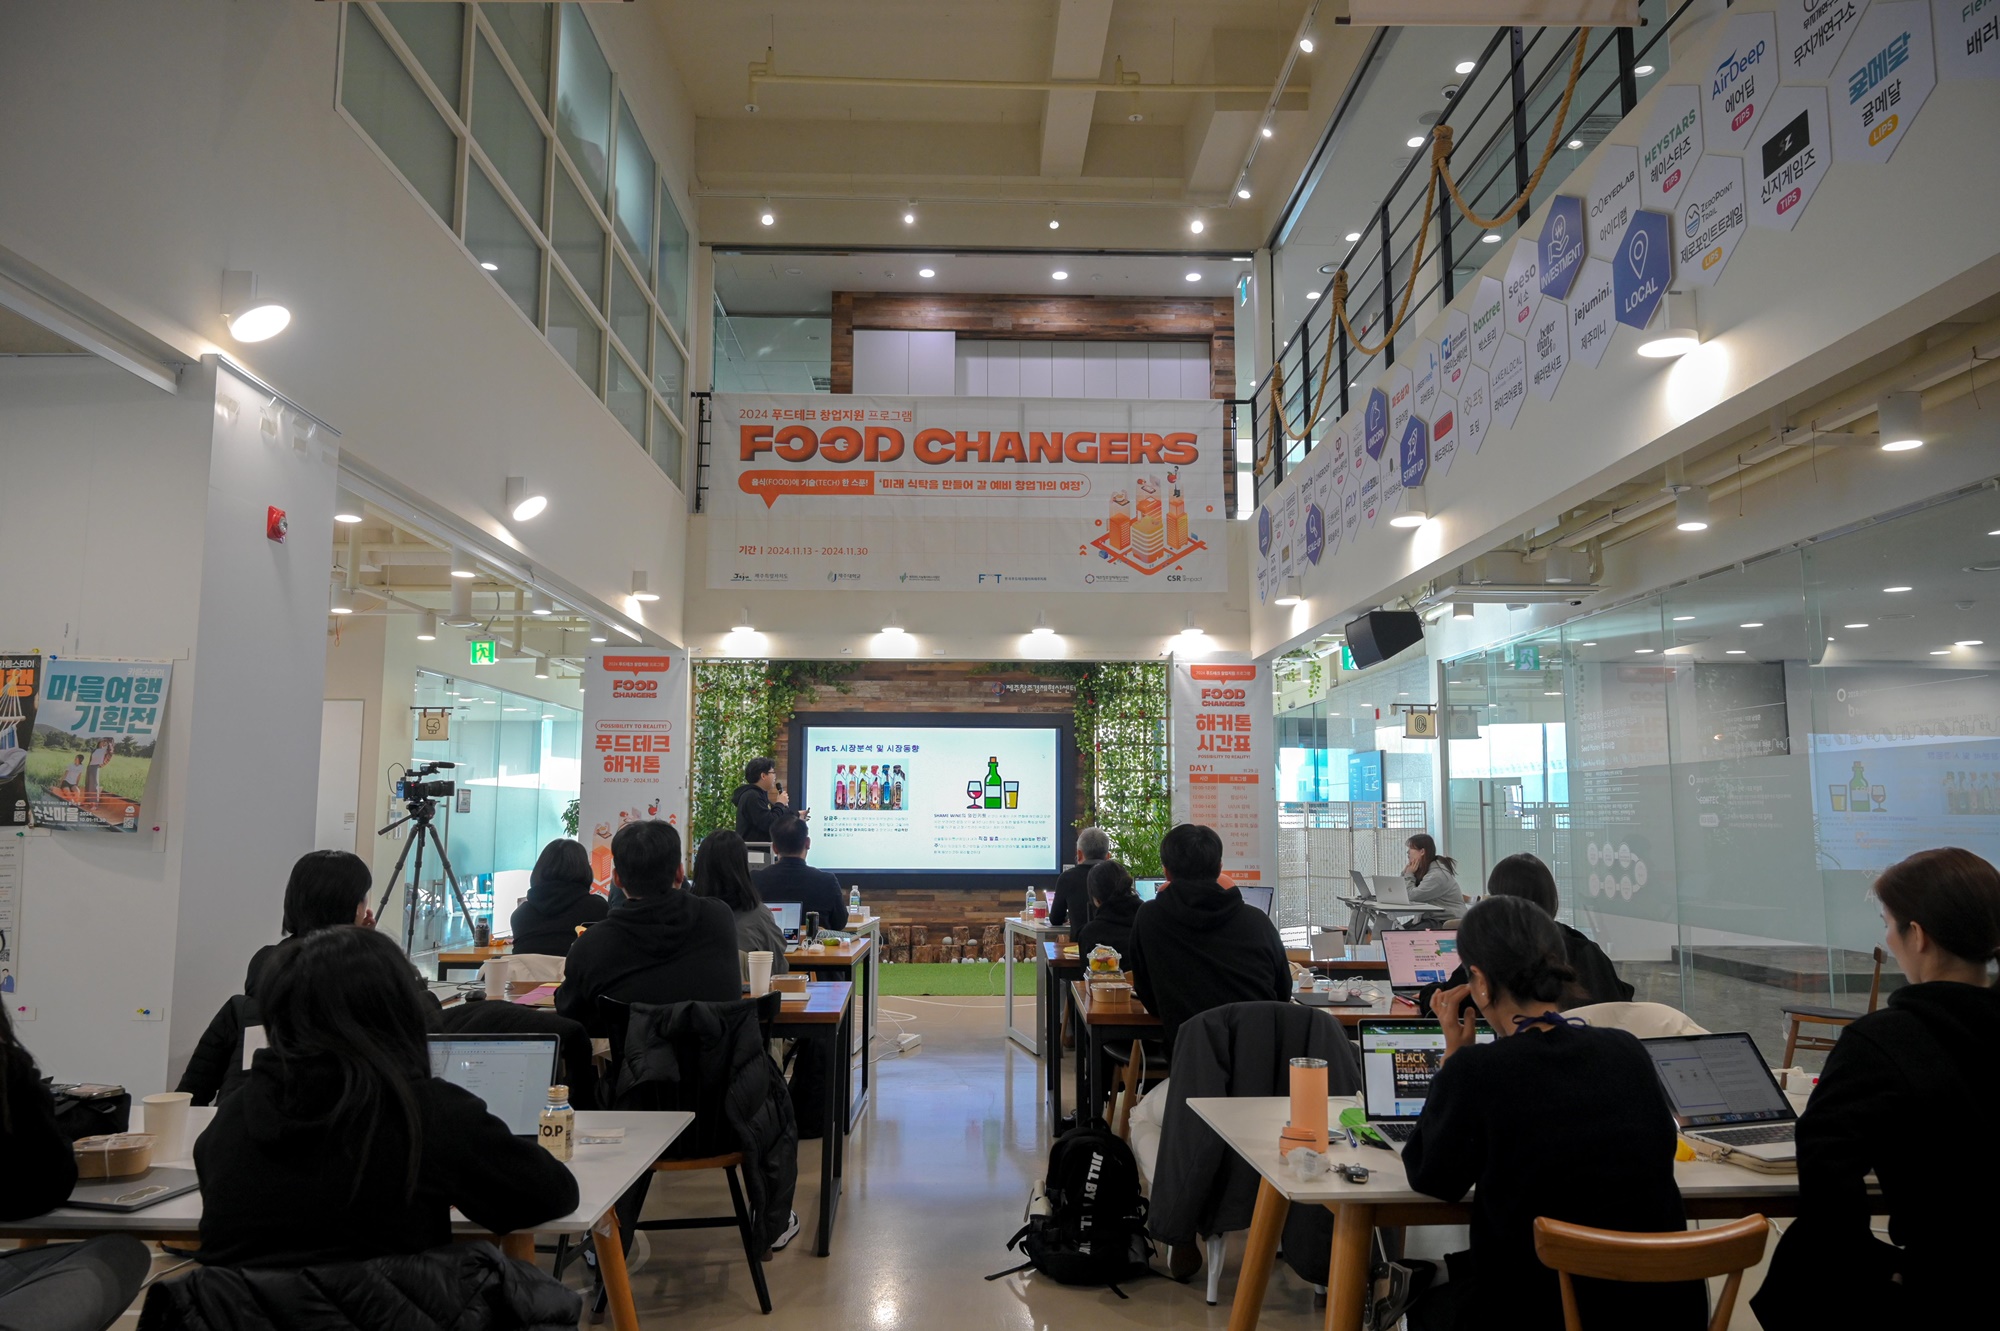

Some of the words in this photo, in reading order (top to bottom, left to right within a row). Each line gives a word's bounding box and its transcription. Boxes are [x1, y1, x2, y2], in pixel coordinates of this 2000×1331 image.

[1794, 4, 1857, 67] 무지개연구소
[1711, 40, 1766, 101] AirDeep
[1725, 75, 1755, 114] 에어딥
[1862, 79, 1902, 128] 귤메달
[1734, 107, 1751, 128] TIPS
[1644, 109, 1696, 169] HEYSTARS
[1872, 118, 1895, 142] LIPS
[1651, 136, 1692, 183] 헤이스타즈
[1664, 172, 1680, 190] TIPS
[1761, 149, 1816, 205] 신지게임즈
[1779, 190, 1798, 213] TIPS
[1600, 206, 1628, 242] 아이디랩
[1680, 202, 1744, 265] 제로포인트트레일
[1540, 241, 1582, 290] INVESTMENT
[1704, 249, 1721, 268] LIPS
[1508, 263, 1536, 299] seeso
[1625, 276, 1659, 314] LOCAL
[1473, 301, 1501, 335] boxtree
[1580, 319, 1607, 350] 제주미니
[739, 409, 768, 419] 2024
[771, 409, 817, 421] 푸드테크
[820, 409, 865, 422] 창업지원
[868, 410, 912, 422] 프로그램
[739, 424, 905, 464] FOOD
[912, 427, 1200, 466] CHANGERS
[1367, 427, 1385, 450] UNICORN
[1403, 464, 1416, 483] START
[1416, 458, 1424, 472] UP
[801, 478, 840, 487] 기술(TECH)
[842, 478, 849, 487] 한
[907, 479, 939, 490] 식탁을
[942, 479, 973, 490] 만들어
[976, 480, 988, 490] 갈
[990, 480, 1012, 490] 예비
[1015, 480, 1057, 491] 창업가의
[739, 545, 757, 555] 기간
[767, 546, 813, 555] 2024.11.13
[821, 547, 868, 556] 2024.11.30
[47, 674, 163, 704] 마을여행
[613, 679, 658, 691] FOOD
[1005, 684, 1077, 694] 제주창조경제혁신센터
[1201, 688, 1246, 700] FOOD
[1201, 700, 1246, 708] CHANGERS
[70, 705, 157, 735] 기획전
[1195, 713, 1252, 732] 해커톤
[595, 734, 671, 753] 푸드테크
[840, 744, 873, 753] 시장분석
[876, 745, 884, 753] 및
[887, 744, 920, 753] 시장동향
[1196, 734, 1251, 752] 시간표
[603, 755, 660, 774] 해커톤
[1189, 764, 1207, 772] DAY
[1209, 764, 1214, 772] 1
[33, 806, 79, 822] 수산마을
[1395, 1053, 1427, 1063] BLACK
[1087, 1151, 1104, 1181] JILL
[1083, 1181, 1098, 1200] BY
